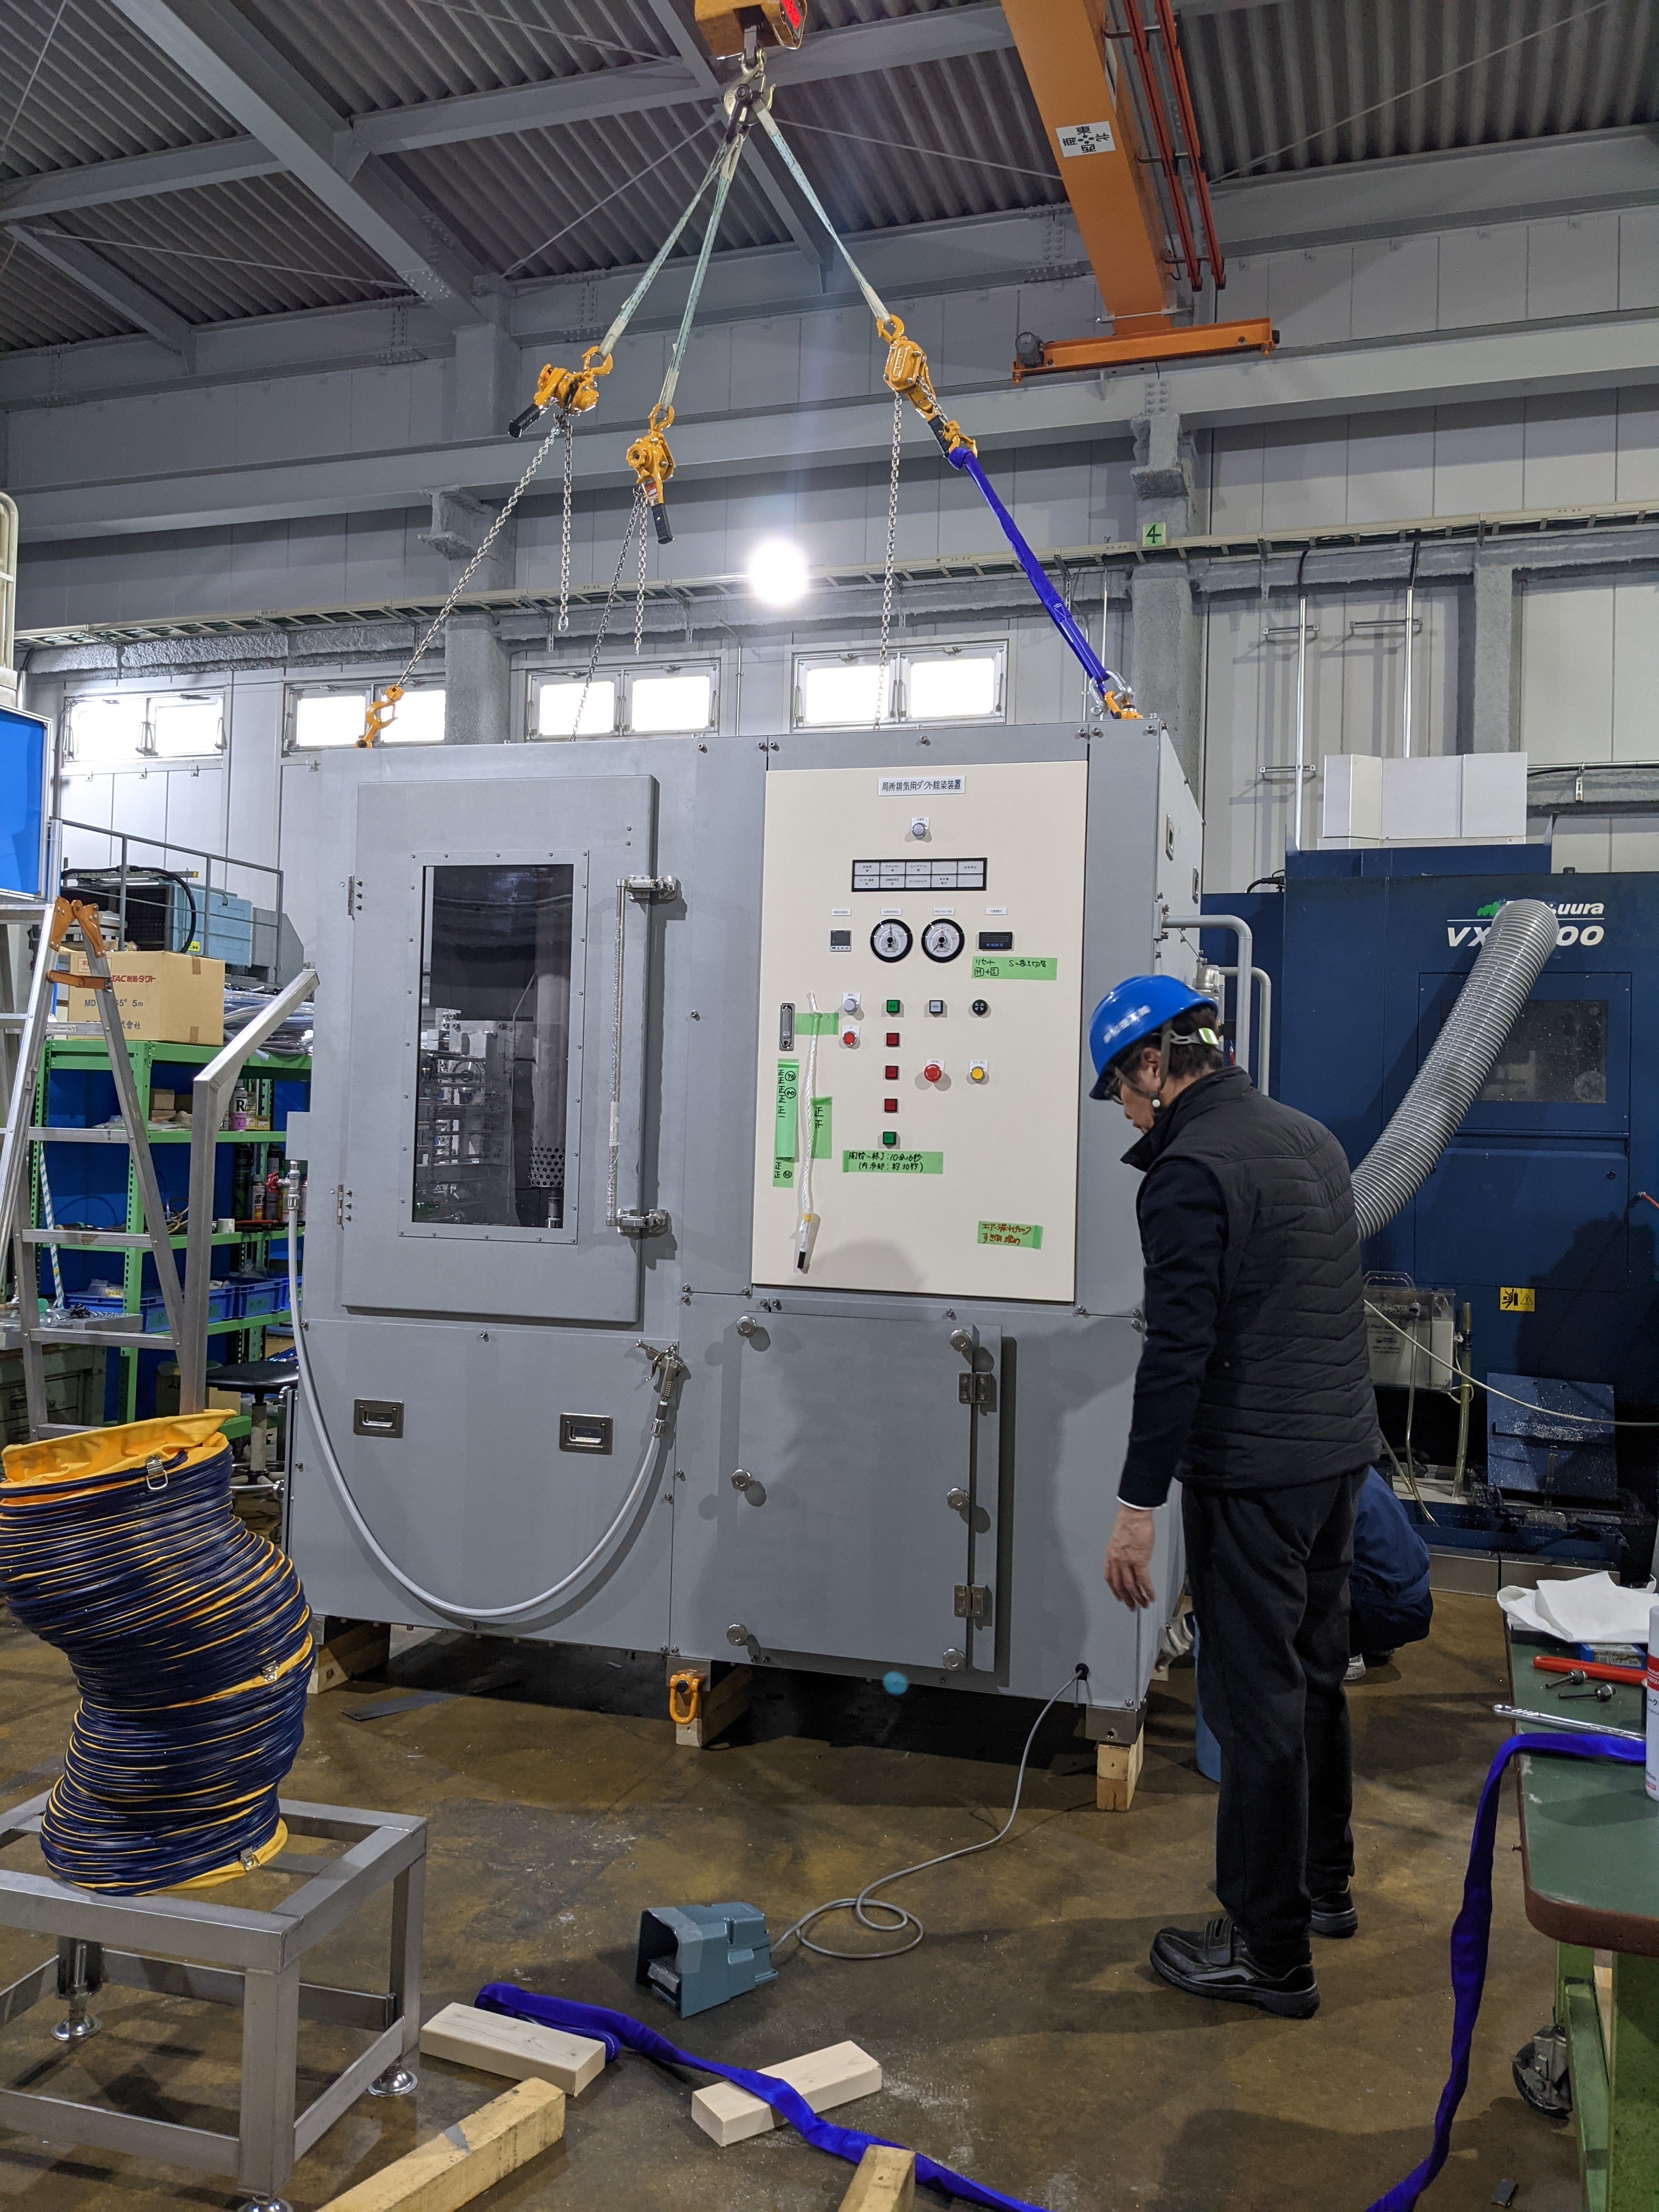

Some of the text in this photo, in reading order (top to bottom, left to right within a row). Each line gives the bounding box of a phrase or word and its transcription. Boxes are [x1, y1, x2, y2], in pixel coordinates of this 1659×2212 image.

[1075, 126, 1092, 135] 東
[1095, 133, 1110, 142] 北
[1081, 144, 1097, 153] 西
[1146, 523, 1161, 544] 4
[882, 779, 962, 792] 局所排気用ダクト除染装置
